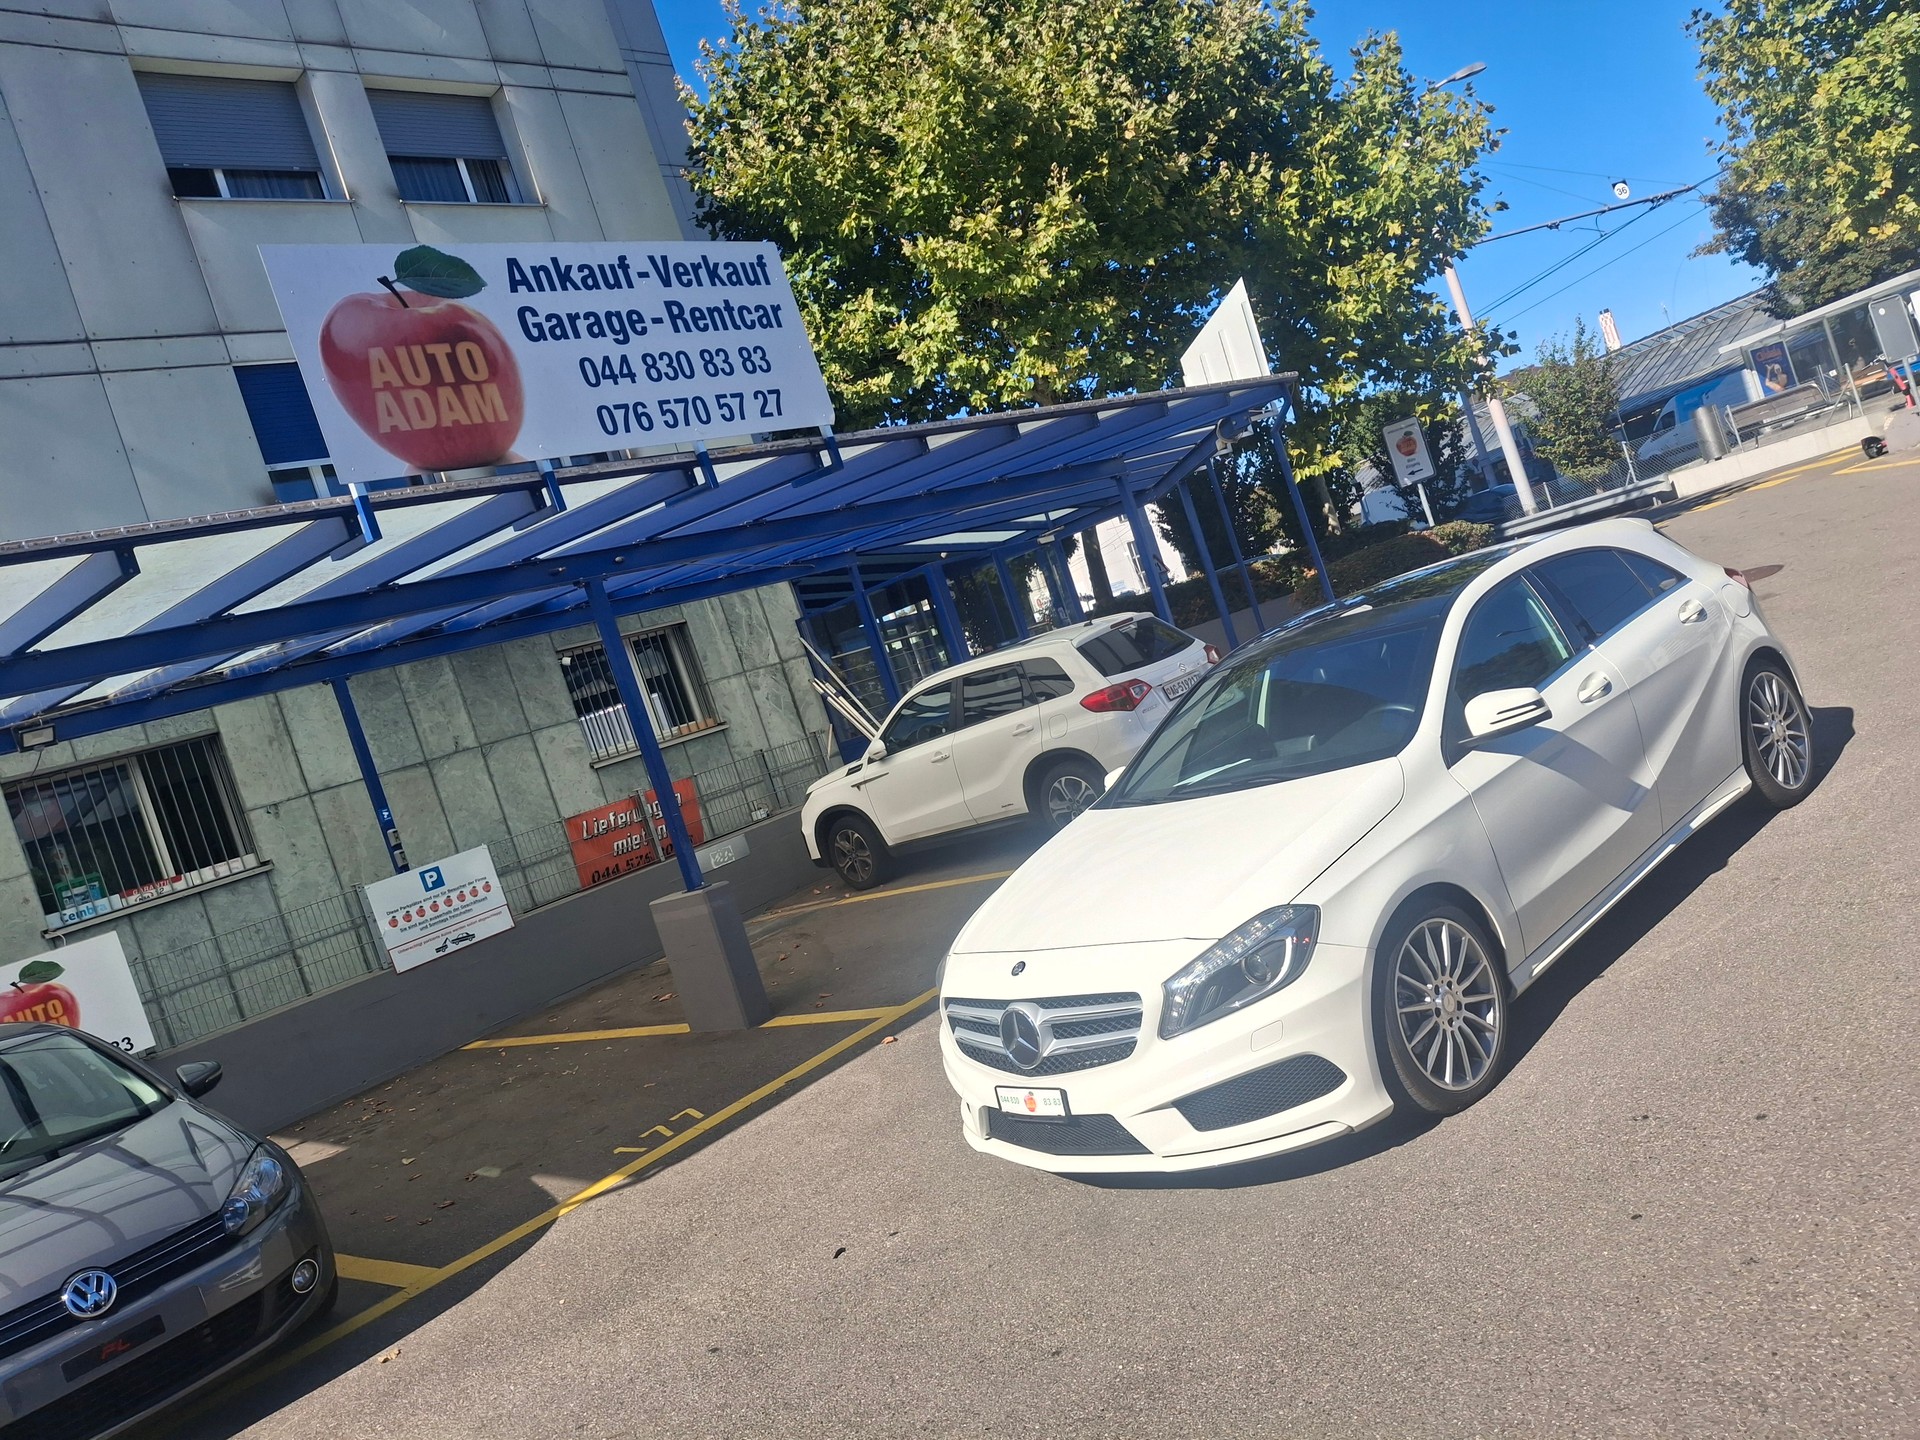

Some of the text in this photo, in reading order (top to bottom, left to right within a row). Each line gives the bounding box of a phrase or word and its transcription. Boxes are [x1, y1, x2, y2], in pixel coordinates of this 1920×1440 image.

[1616, 186, 1628, 196] 36
[506, 254, 771, 293] Ankauf-Verkauf
[517, 299, 783, 345] Garage-Rentcar
[367, 341, 489, 389] AUTO
[579, 345, 772, 387] 044 830 83 83
[374, 382, 509, 434] ADAM
[596, 389, 783, 436] 076 570 57 27
[613, 824, 668, 857] mietn
[424, 871, 438, 888] P
